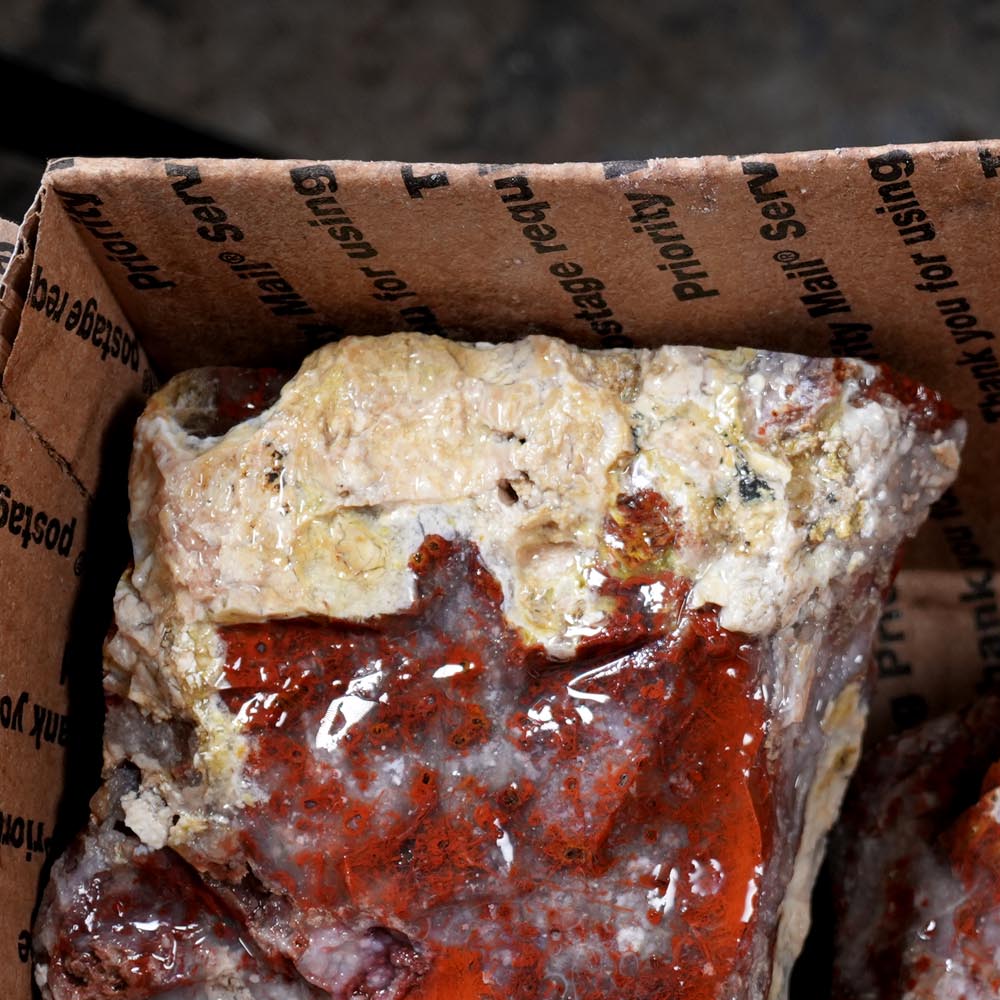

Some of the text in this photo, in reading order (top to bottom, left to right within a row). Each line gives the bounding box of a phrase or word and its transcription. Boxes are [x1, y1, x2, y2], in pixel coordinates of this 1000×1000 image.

[53, 187, 177, 290] Priority
[290, 164, 378, 259] using
[867, 149, 936, 246] using
[360, 267, 417, 301] for
[624, 192, 720, 301] Priority
[910, 252, 959, 292] for
[65, 297, 140, 372] postage
[936, 297, 995, 345] you
